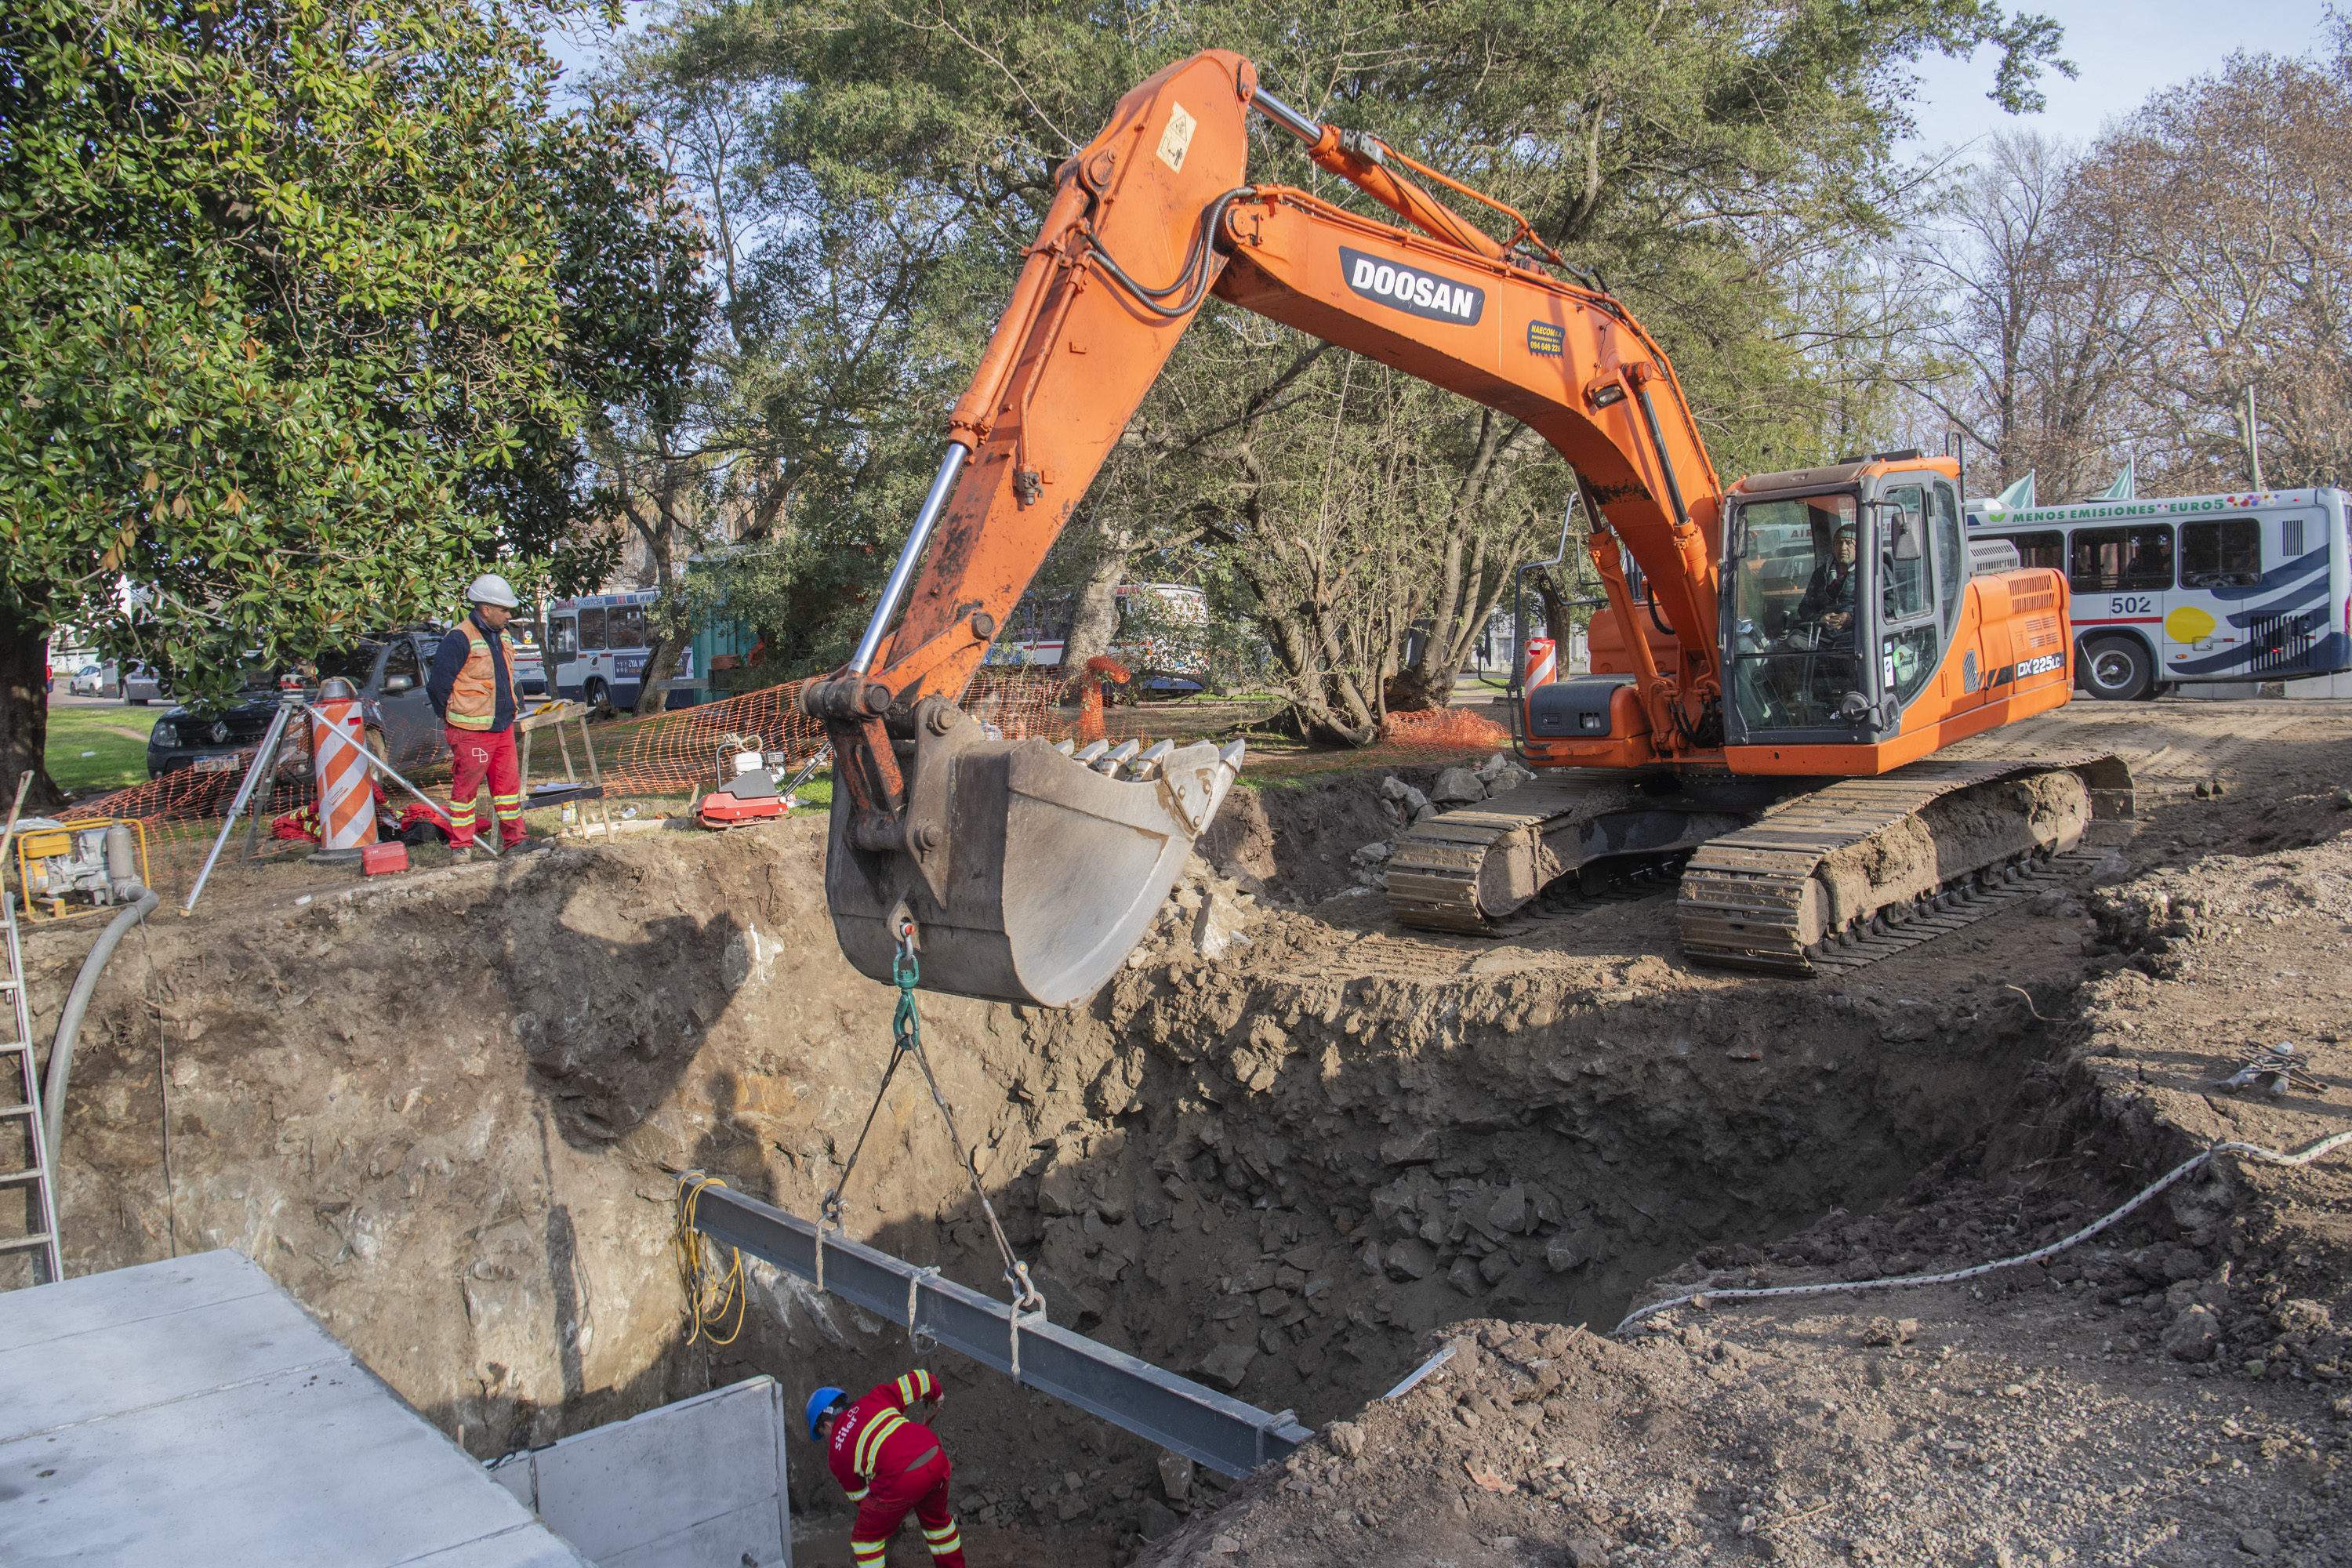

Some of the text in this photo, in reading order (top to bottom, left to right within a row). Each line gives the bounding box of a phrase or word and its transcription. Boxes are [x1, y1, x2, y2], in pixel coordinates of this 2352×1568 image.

[1352, 258, 1474, 318] DOOSAN
[1531, 325, 1555, 336] NAECOM
[1530, 341, 1541, 350] 094
[1541, 343, 1552, 351] 649
[2013, 510, 2065, 523] MENOS
[2071, 504, 2155, 518] EMISIONES
[2111, 596, 2151, 614] 502
[835, 1415, 857, 1451] stiler
